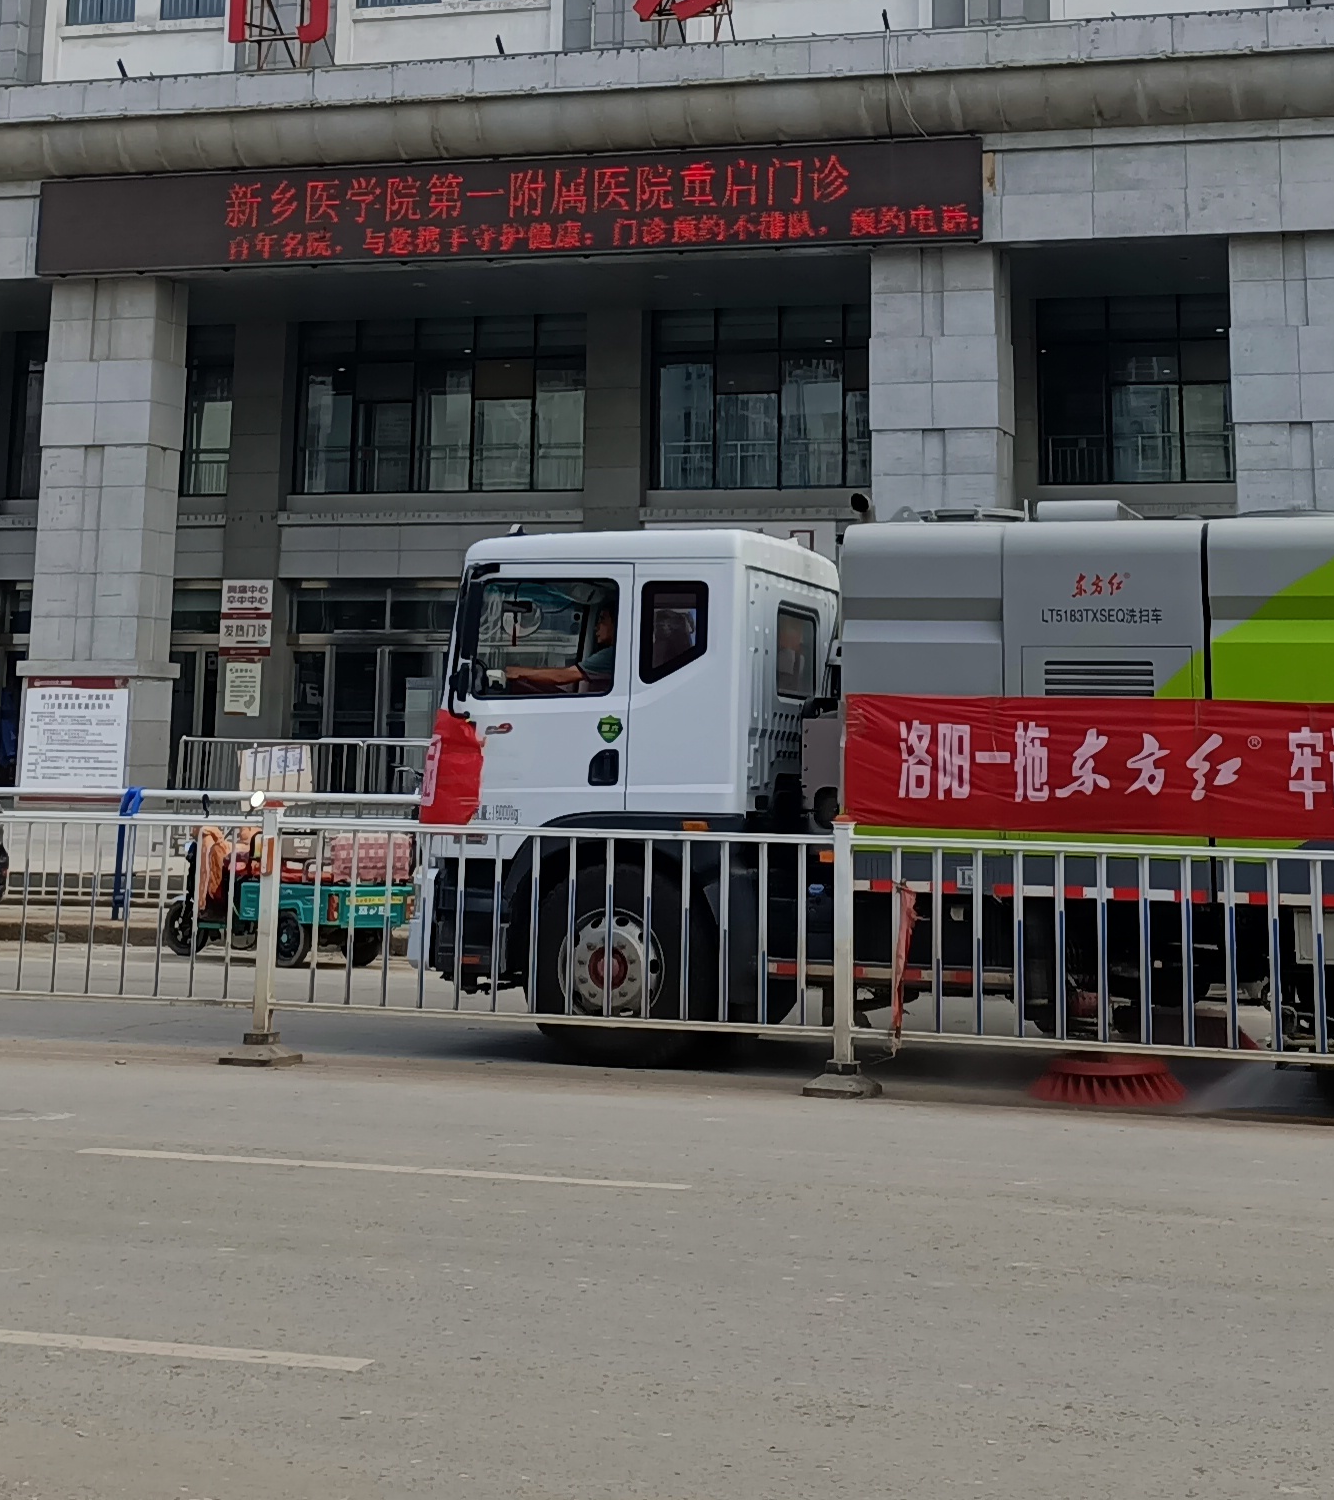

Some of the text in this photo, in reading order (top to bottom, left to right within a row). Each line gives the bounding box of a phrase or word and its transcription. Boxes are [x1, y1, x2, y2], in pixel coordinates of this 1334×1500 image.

[1072, 573, 1124, 598] 东方红
[224, 624, 267, 638] 发热门诊
